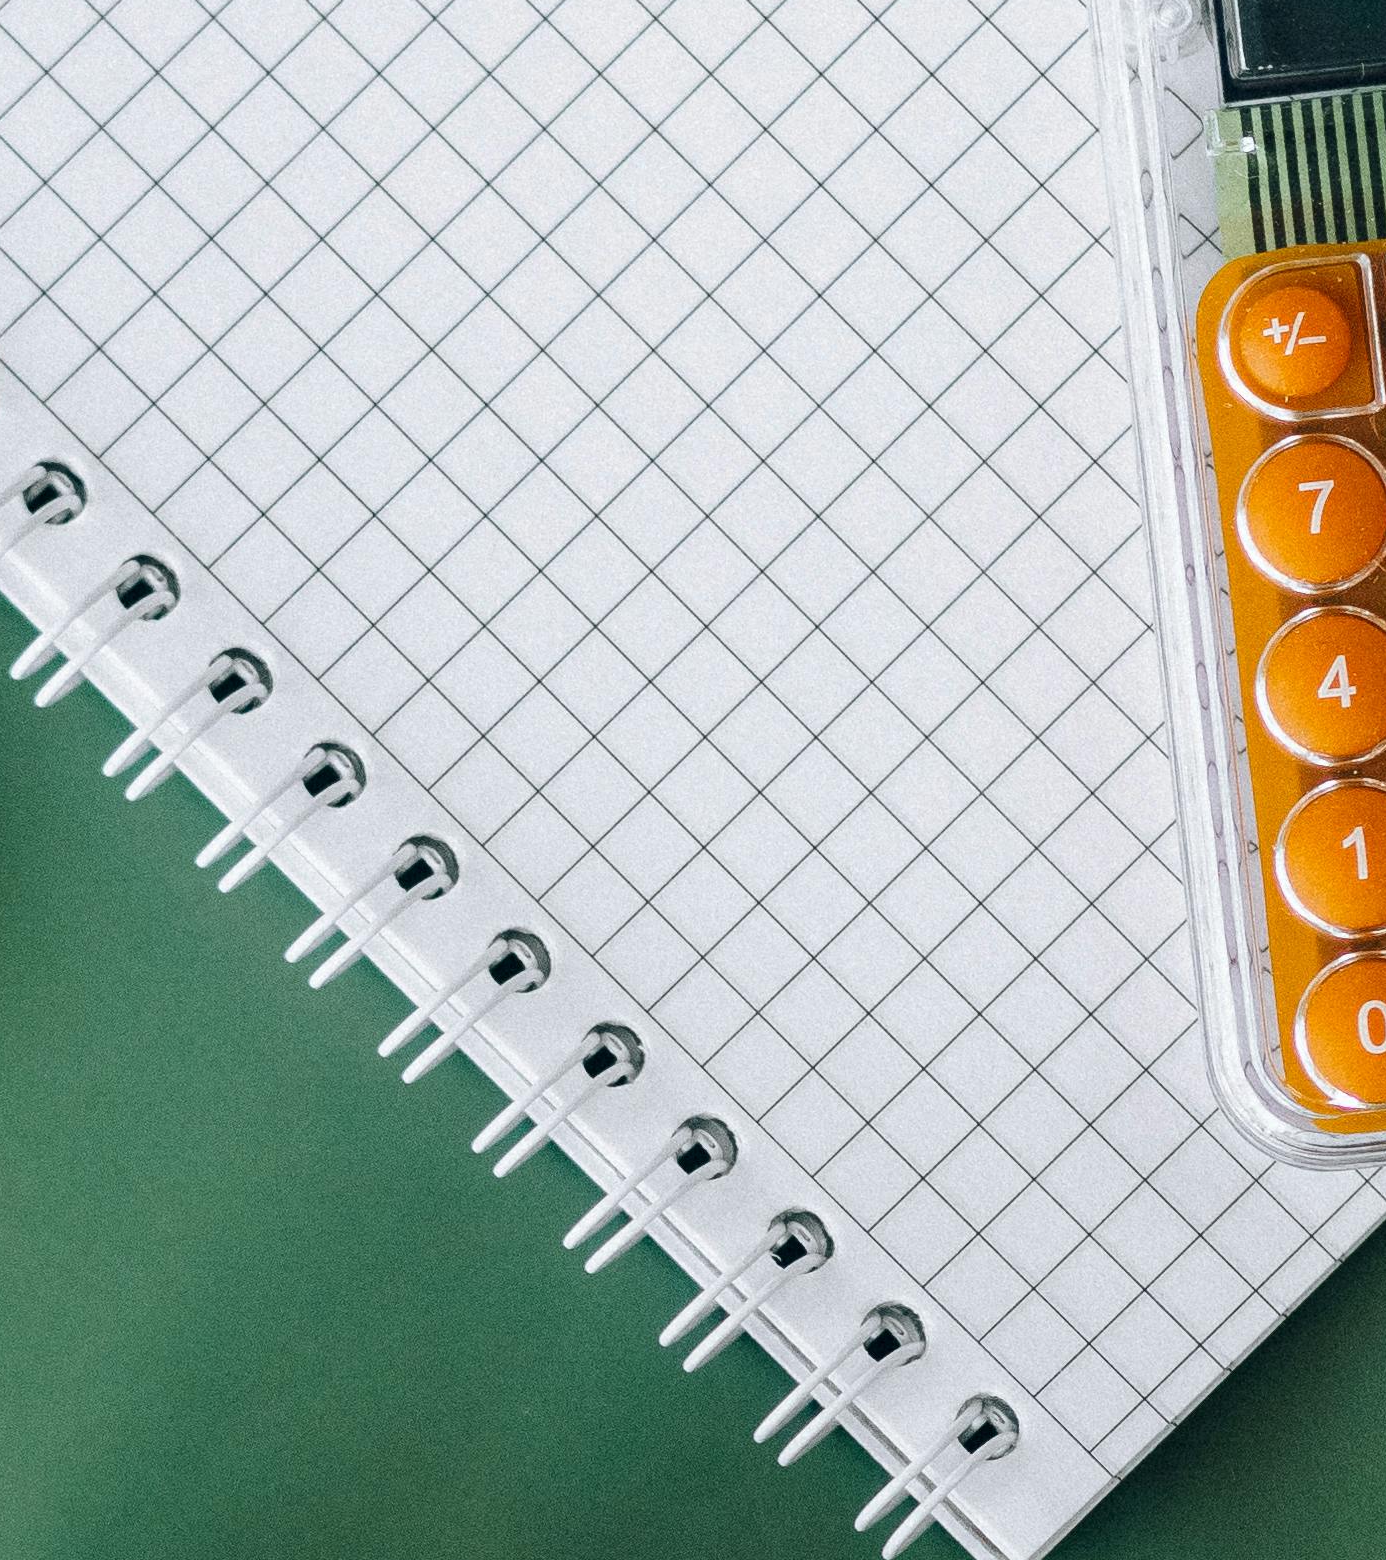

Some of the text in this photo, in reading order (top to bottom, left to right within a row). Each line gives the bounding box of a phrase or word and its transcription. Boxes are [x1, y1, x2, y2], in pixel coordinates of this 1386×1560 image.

[1297, 479, 1335, 535] 7
[1316, 654, 1358, 709] 4
[1341, 825, 1369, 881] 1
